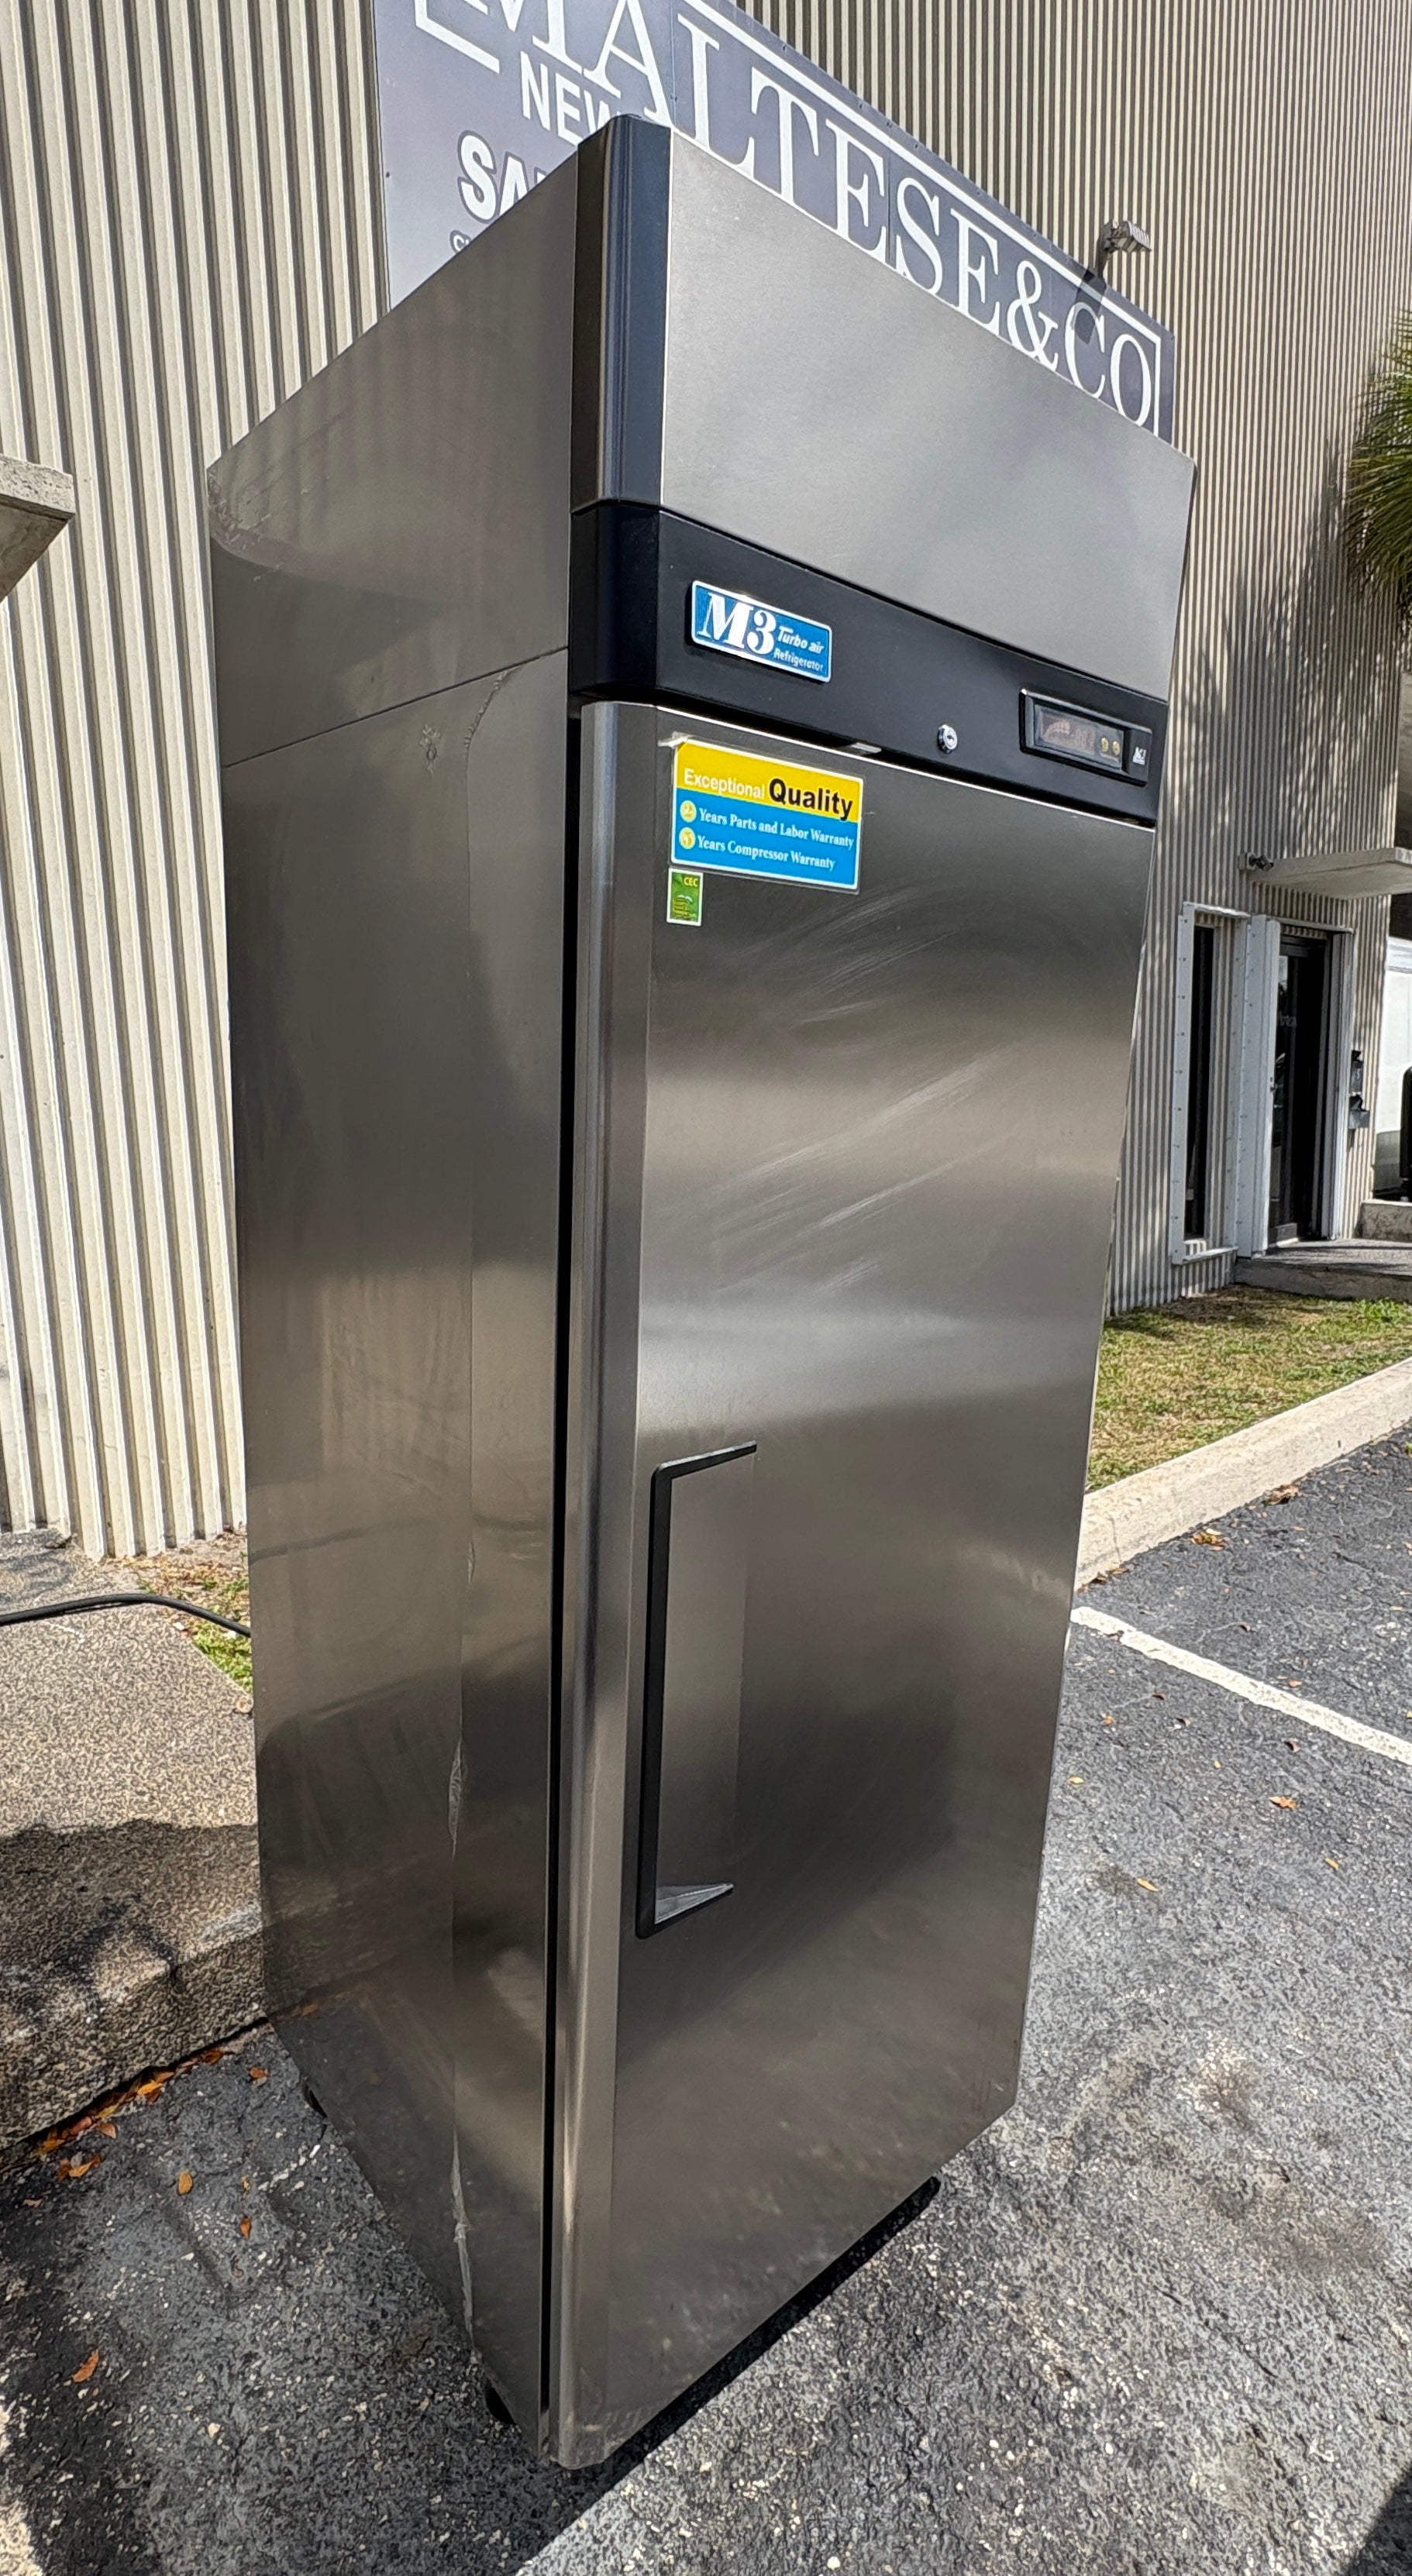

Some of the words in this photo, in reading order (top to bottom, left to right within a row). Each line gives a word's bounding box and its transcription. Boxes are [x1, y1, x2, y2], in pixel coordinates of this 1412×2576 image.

[520, 51, 625, 146] NE
[459, 132, 546, 222] SA
[697, 592, 777, 655] M3
[777, 625, 808, 648] Turbo
[808, 641, 825, 655] air
[773, 647, 825, 672] Refrigerator
[684, 768, 765, 800] Exceptional
[769, 778, 853, 821] Quality
[699, 807, 728, 826] Years
[729, 813, 757, 831] Parts
[758, 820, 778, 834] and
[780, 823, 809, 840] Labor
[810, 828, 855, 851] Warranty
[697, 834, 726, 852] Years
[727, 840, 789, 862] Compressor
[790, 850, 836, 872] Warranty
[684, 876, 699, 888] CEC
